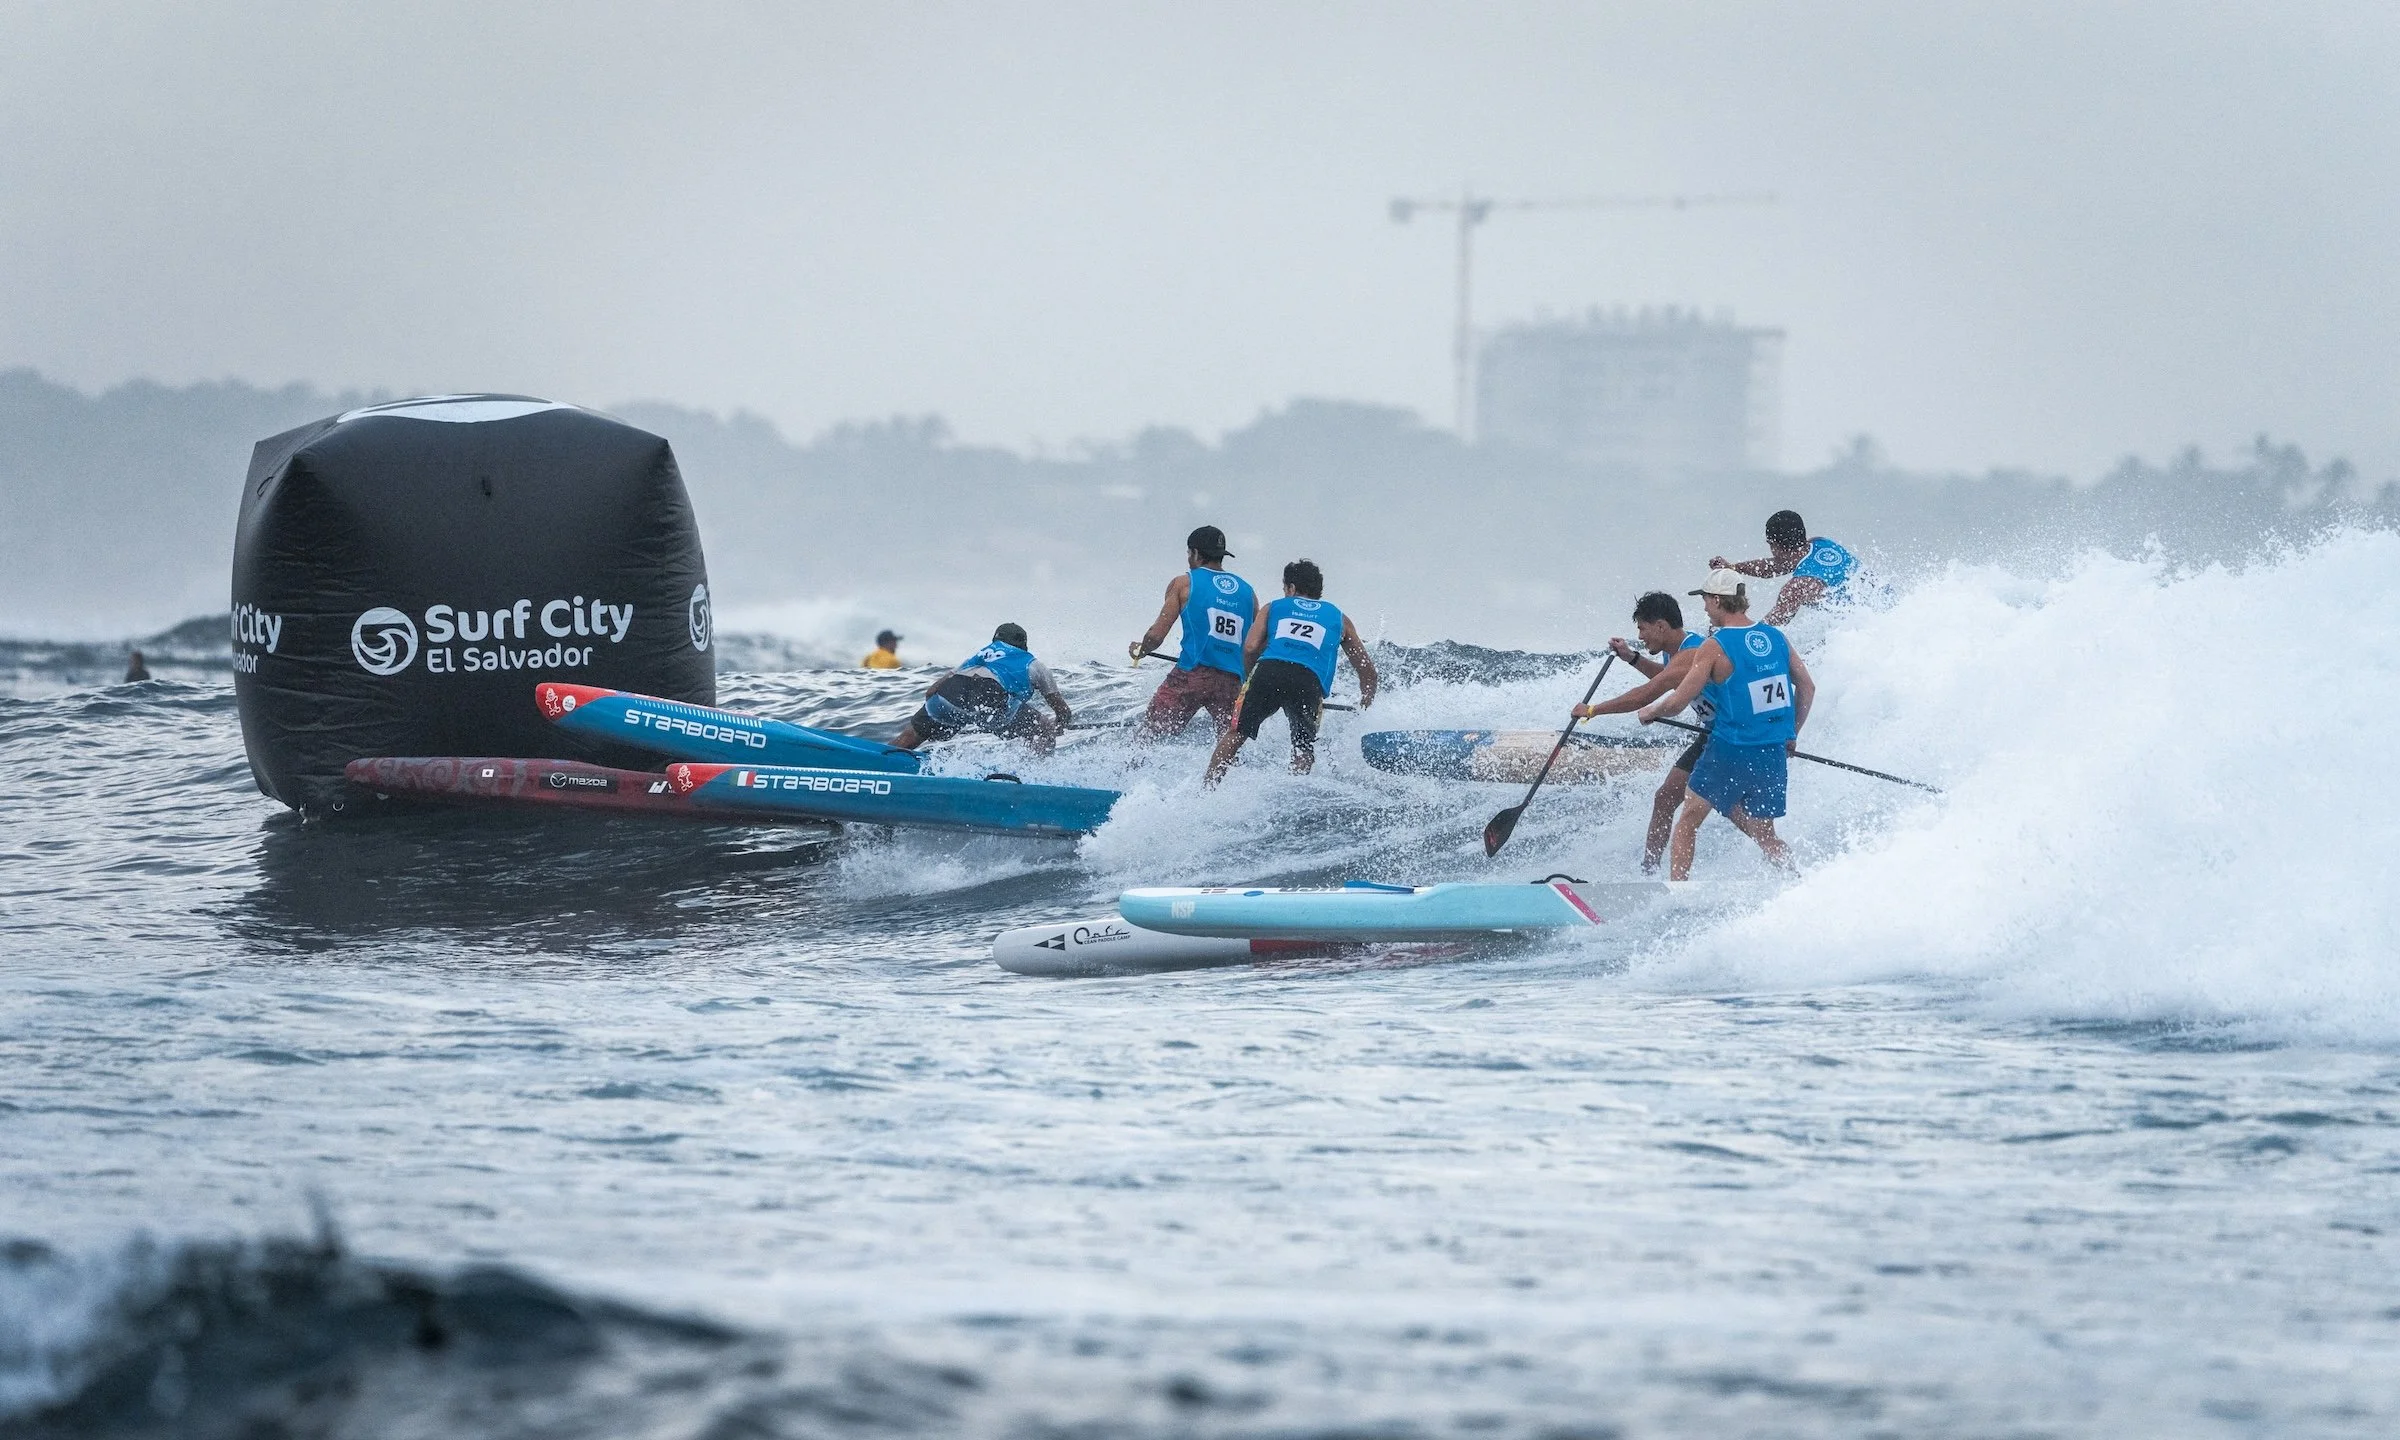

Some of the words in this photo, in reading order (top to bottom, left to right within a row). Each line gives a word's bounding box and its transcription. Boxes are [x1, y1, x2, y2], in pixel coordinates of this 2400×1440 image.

[240, 602, 282, 654] City
[424, 599, 532, 643] Surf
[540, 595, 634, 643] City
[1215, 615, 1236, 637] 85
[1290, 622, 1314, 639] 72
[426, 647, 457, 673] El
[463, 643, 594, 672] Salvador
[1763, 681, 1785, 704] 74
[624, 708, 768, 749] STARBOARD
[568, 777, 608, 787] mazda
[752, 774, 892, 796] STARBOARD
[1171, 900, 1196, 919] NSP
